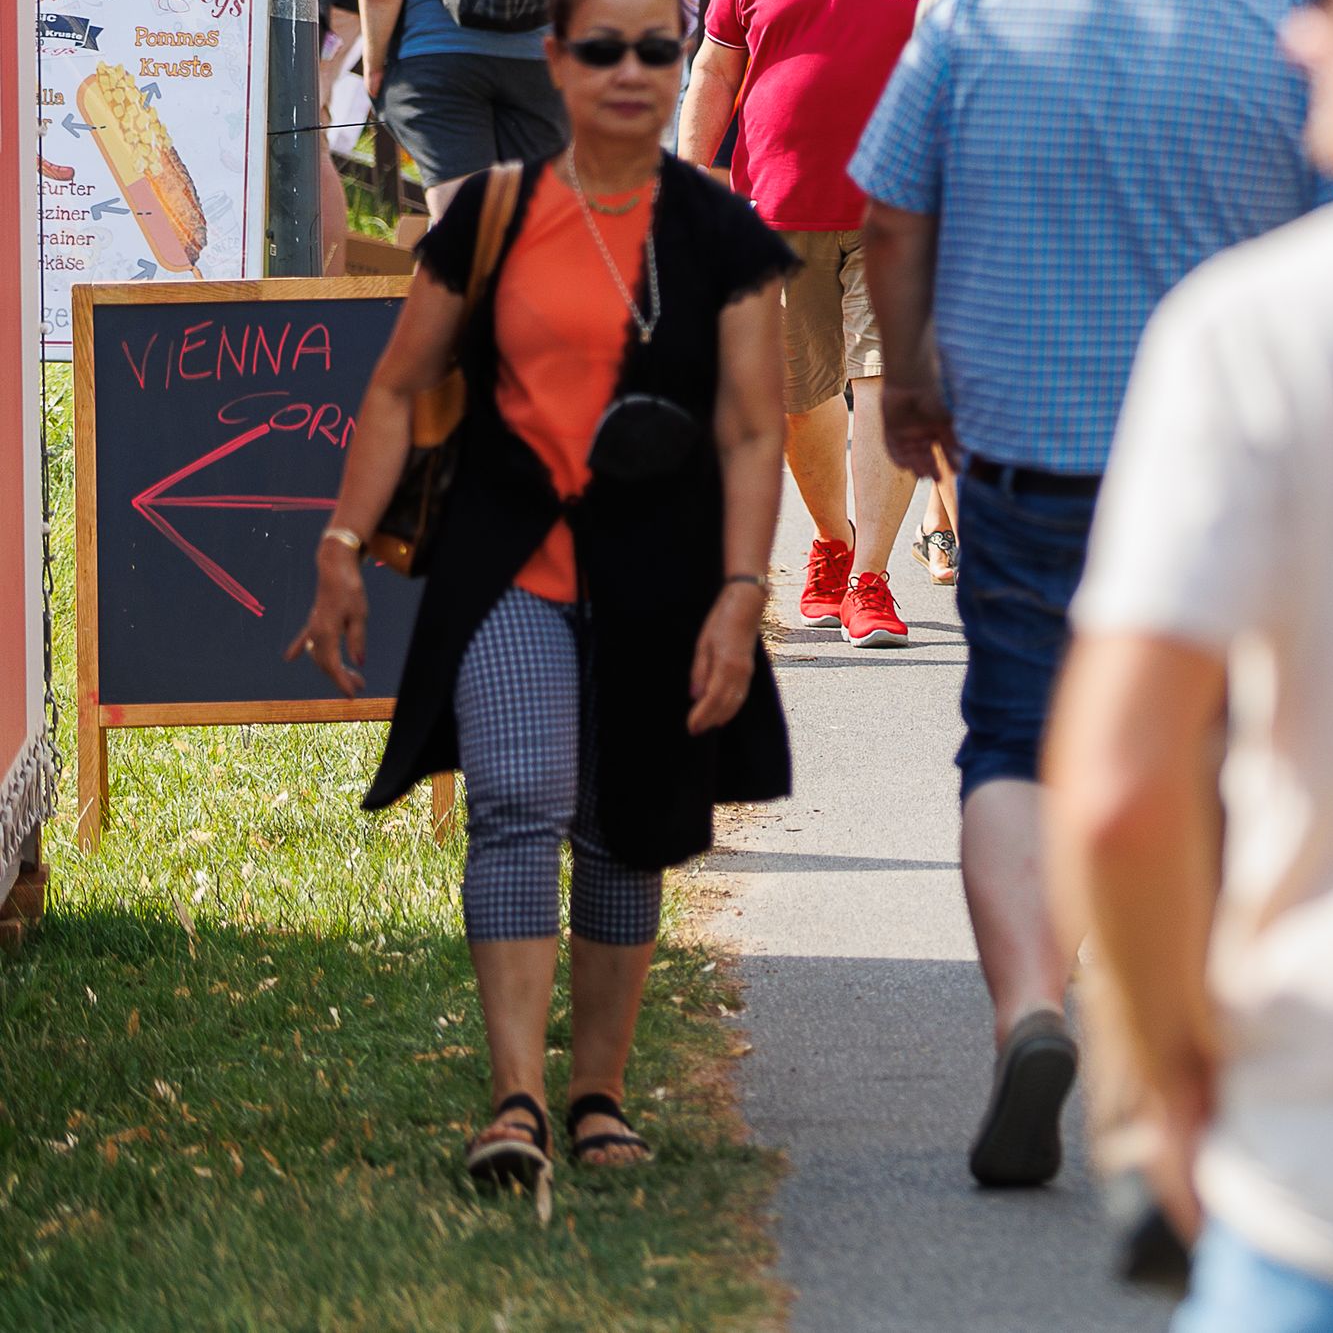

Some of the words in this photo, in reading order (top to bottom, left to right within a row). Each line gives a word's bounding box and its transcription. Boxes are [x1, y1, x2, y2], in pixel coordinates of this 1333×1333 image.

[134, 26, 220, 48] Pommes
[139, 55, 214, 78] Kruste
[37, 180, 96, 196] furter
[38, 230, 95, 246] rainer
[121, 320, 331, 390] VIENNA
